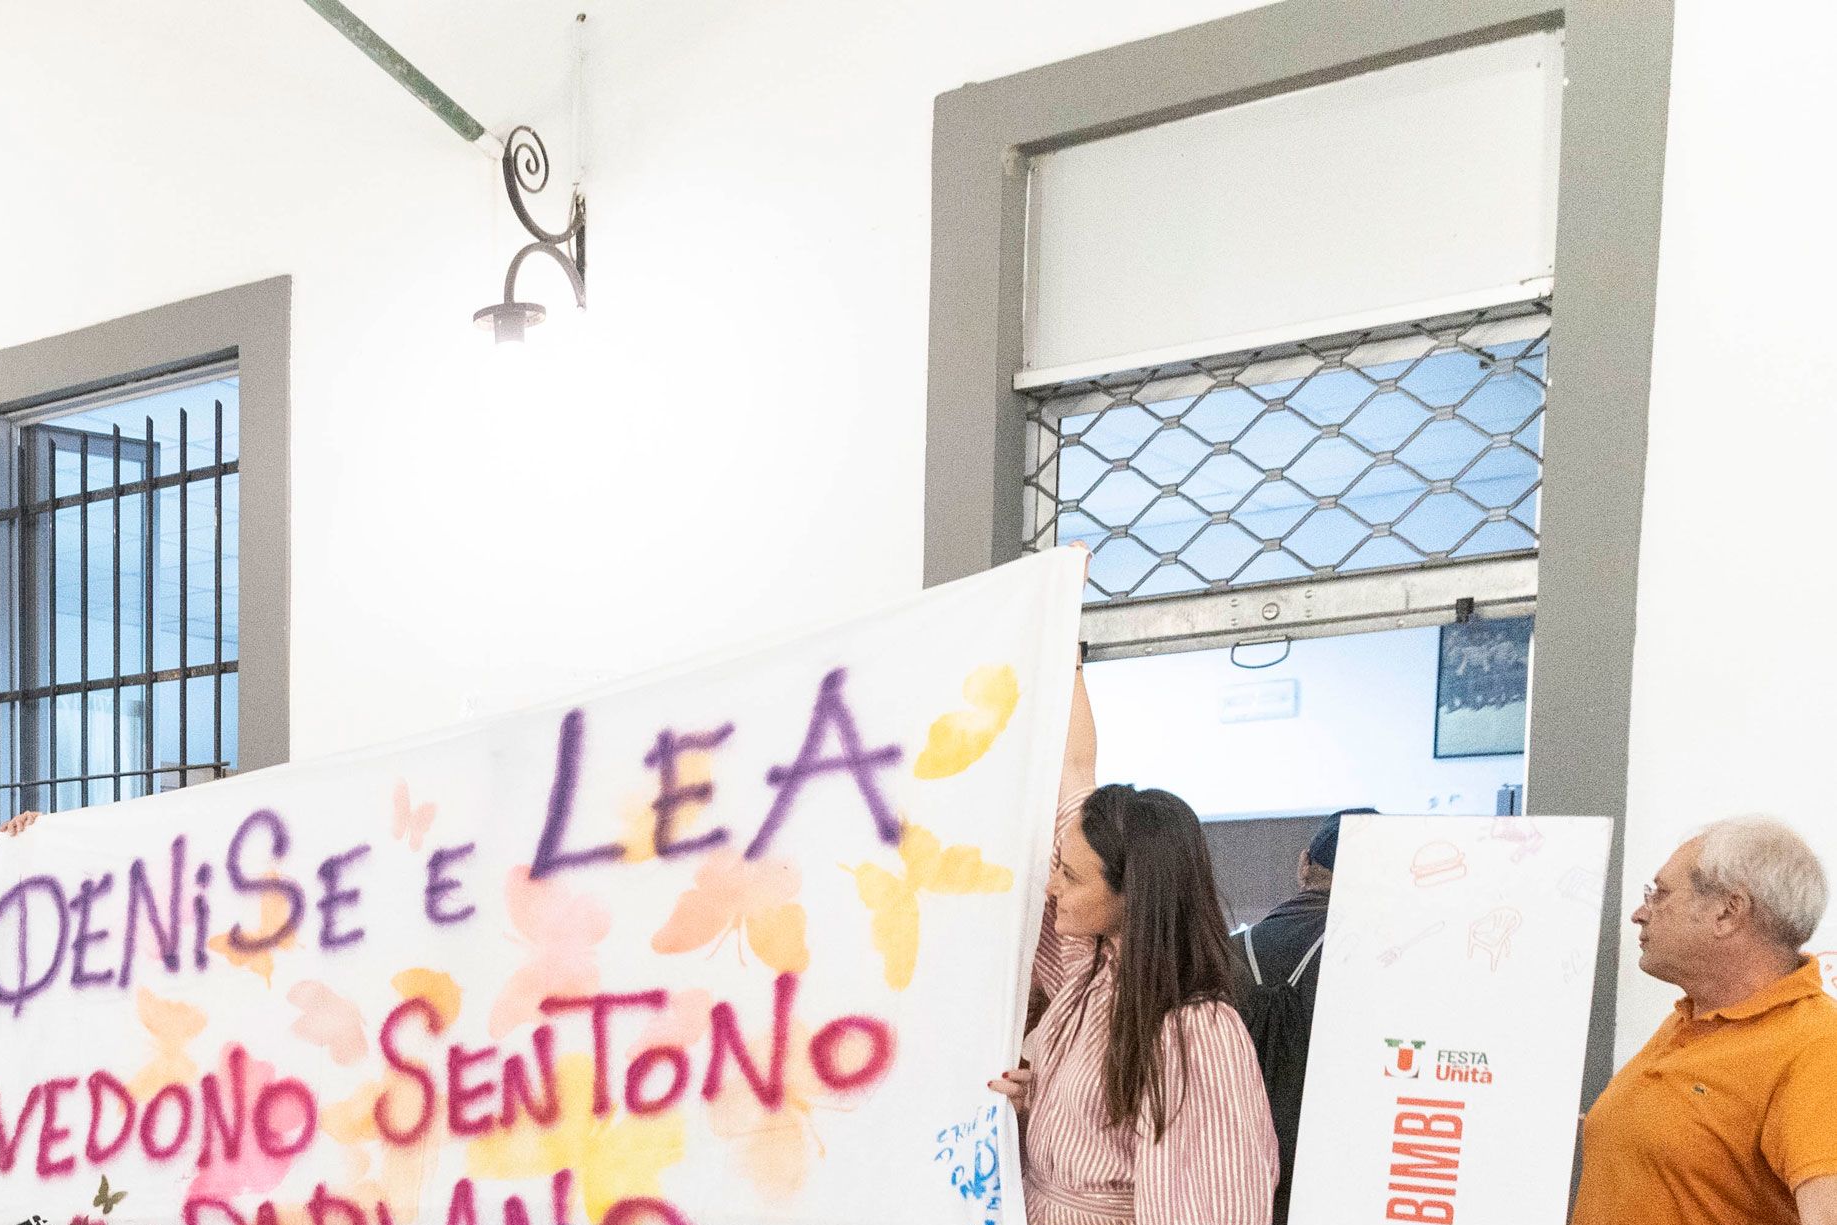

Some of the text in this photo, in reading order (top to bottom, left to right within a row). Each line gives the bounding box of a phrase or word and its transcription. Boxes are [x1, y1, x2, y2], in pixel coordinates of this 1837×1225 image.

[424, 842, 476, 925] E
[529, 667, 904, 880] LEA
[1435, 1064, 1493, 1084] Unità
[1437, 1049, 1489, 1065] FESTA
[1386, 1096, 1466, 1225] BIMBI
